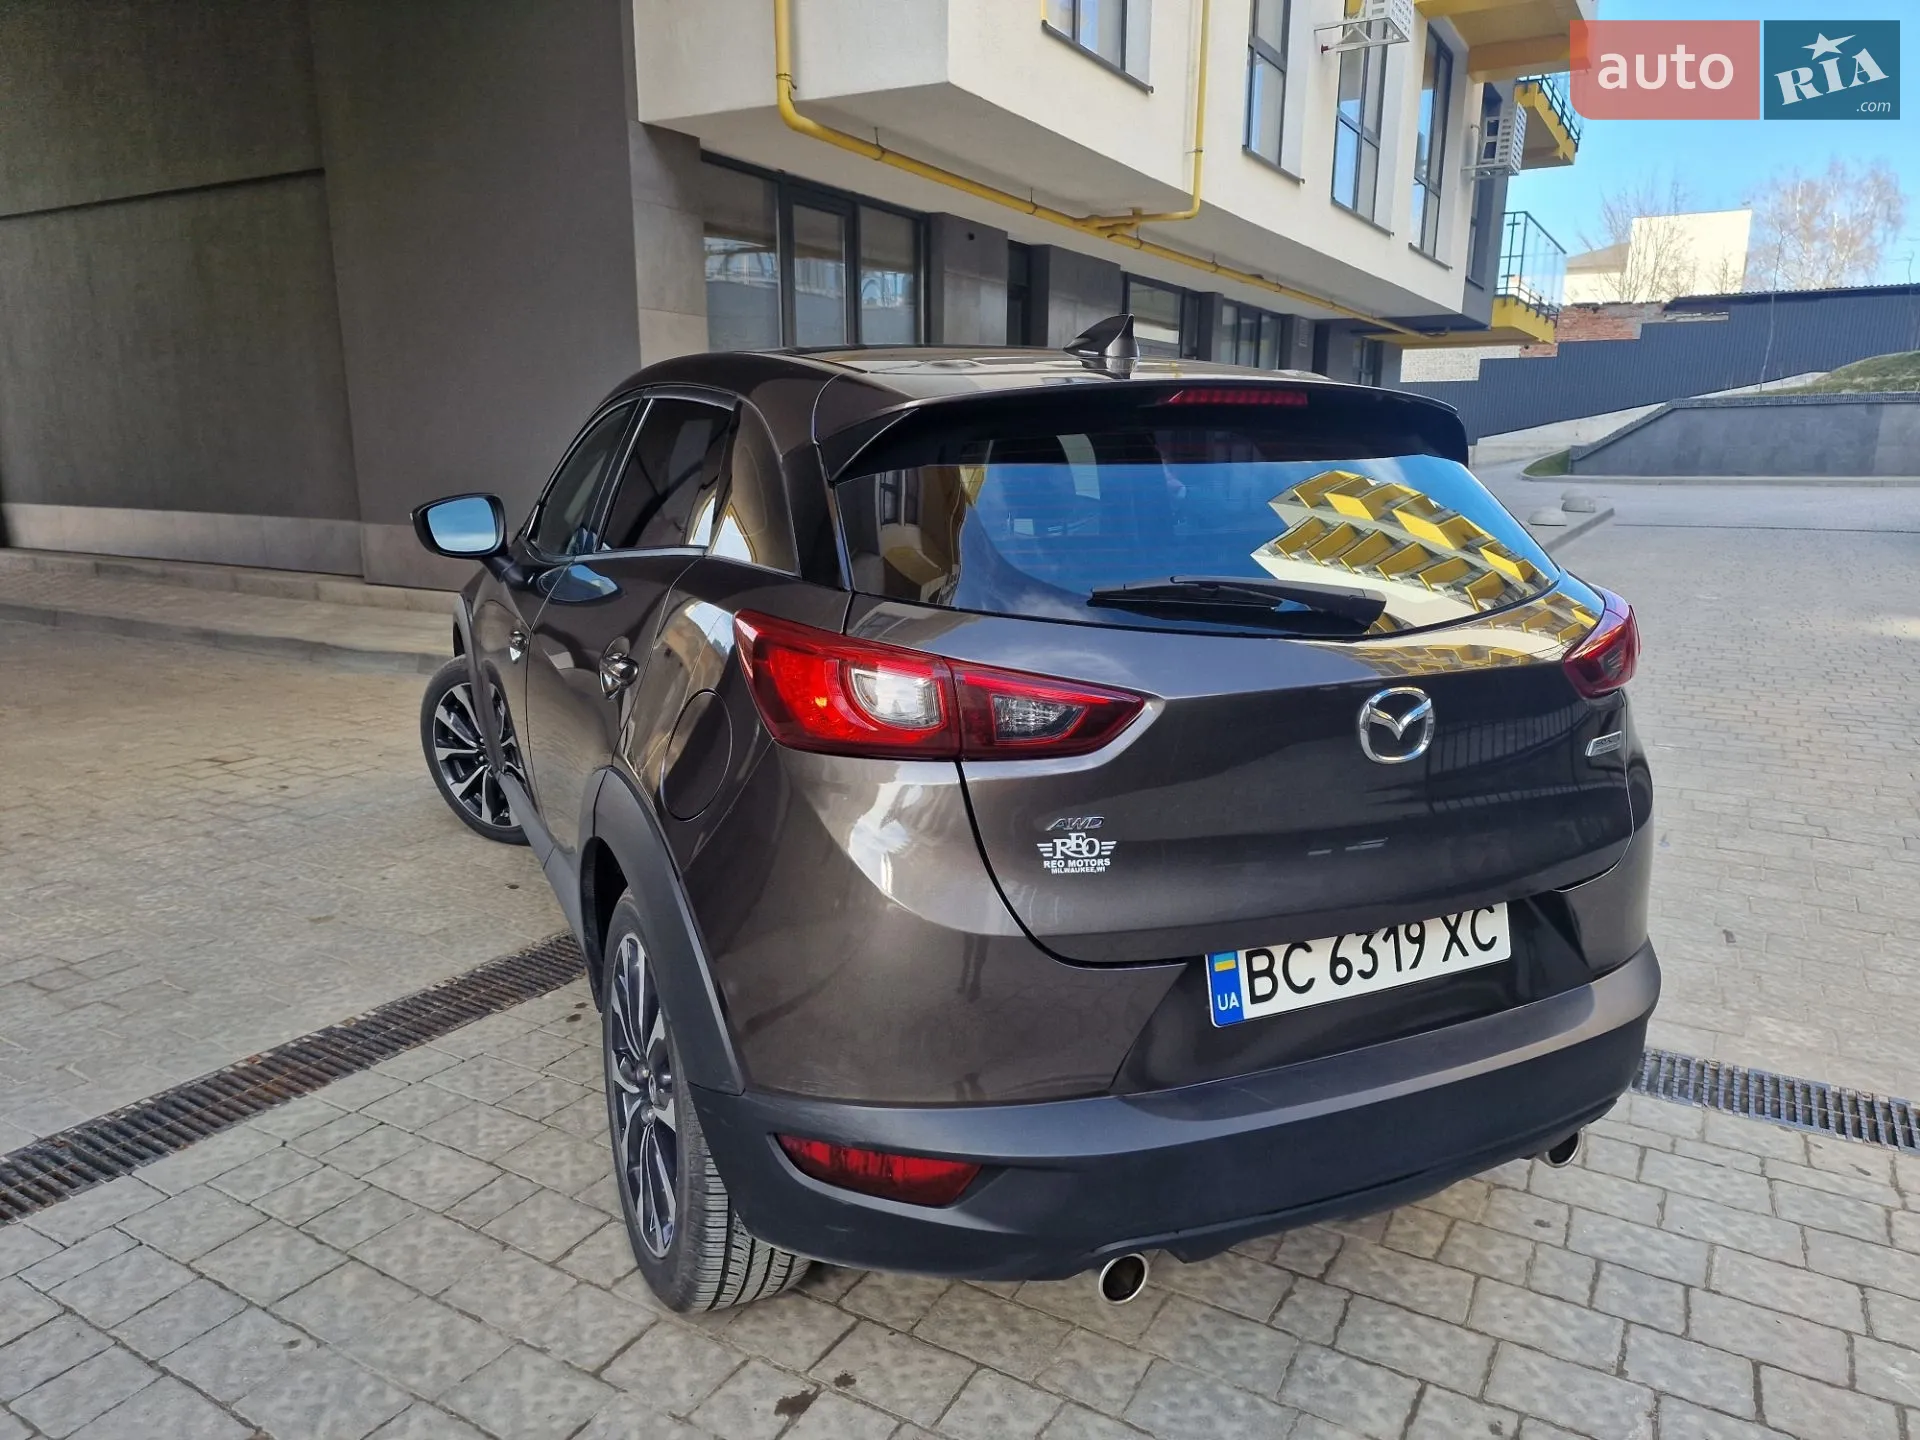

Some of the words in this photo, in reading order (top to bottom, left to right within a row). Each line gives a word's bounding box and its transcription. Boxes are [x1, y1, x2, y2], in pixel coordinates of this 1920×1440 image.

[1046, 816, 1104, 831] AWD
[1053, 832, 1100, 858] REO
[1043, 860, 1064, 868] REO
[1068, 858, 1110, 867] MOTORS
[1245, 942, 1315, 1005] BC
[1330, 921, 1426, 986] 6319
[1442, 905, 1497, 962] XC
[1217, 991, 1240, 1011] UA
